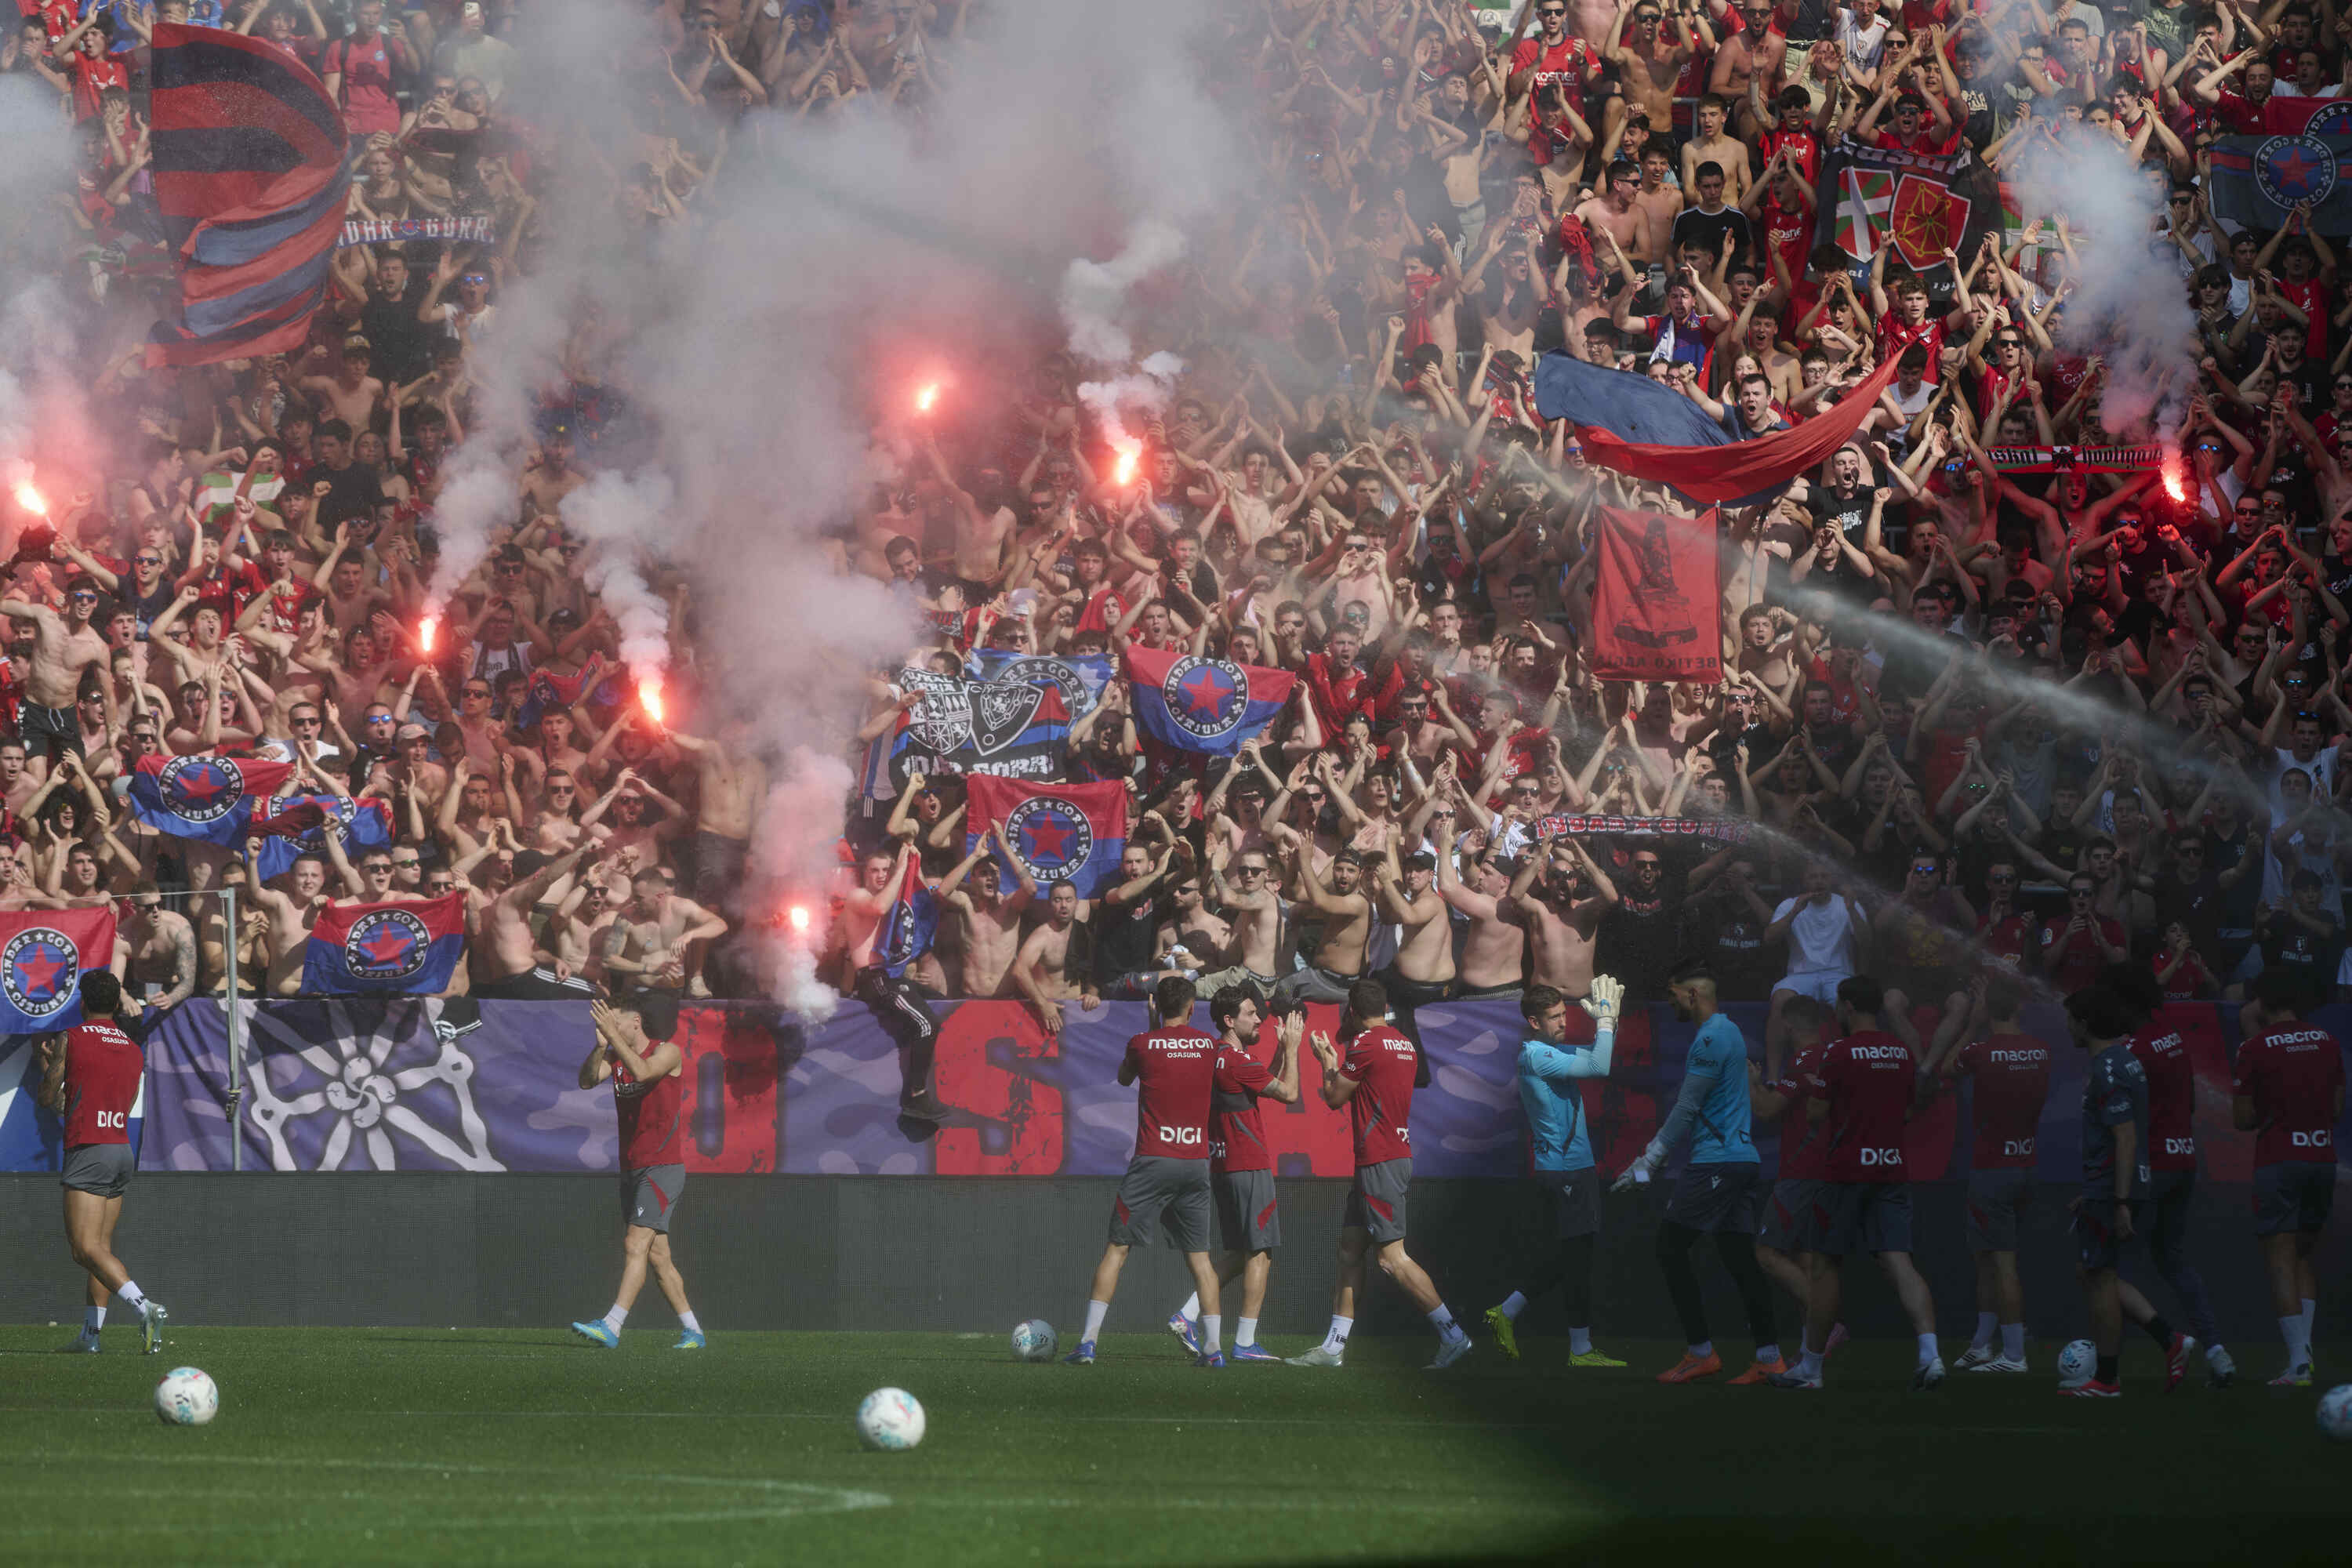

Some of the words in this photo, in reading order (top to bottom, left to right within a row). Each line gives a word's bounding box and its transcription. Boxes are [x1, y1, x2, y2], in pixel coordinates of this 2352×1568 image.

[1167, 657, 1202, 691] INDAR
[1217, 659, 1245, 700] GORRI
[1171, 706, 1234, 734] OSASUNA
[1008, 801, 1040, 837] INDAR
[1056, 801, 1089, 840] GORRI
[1537, 816, 1625, 838] INDAR
[393, 913, 427, 947] GORRI
[4, 934, 31, 974] INDAR
[47, 932, 77, 972] GORRI
[12, 991, 67, 1014] OSASUNA
[1148, 1038, 1214, 1049] macron
[1382, 1039, 1416, 1051] macro
[2265, 1030, 2330, 1047] macron
[1851, 1046, 1908, 1060] macron
[1160, 1126, 1202, 1144] DIGI
[2292, 1130, 2331, 1147] DIGI
